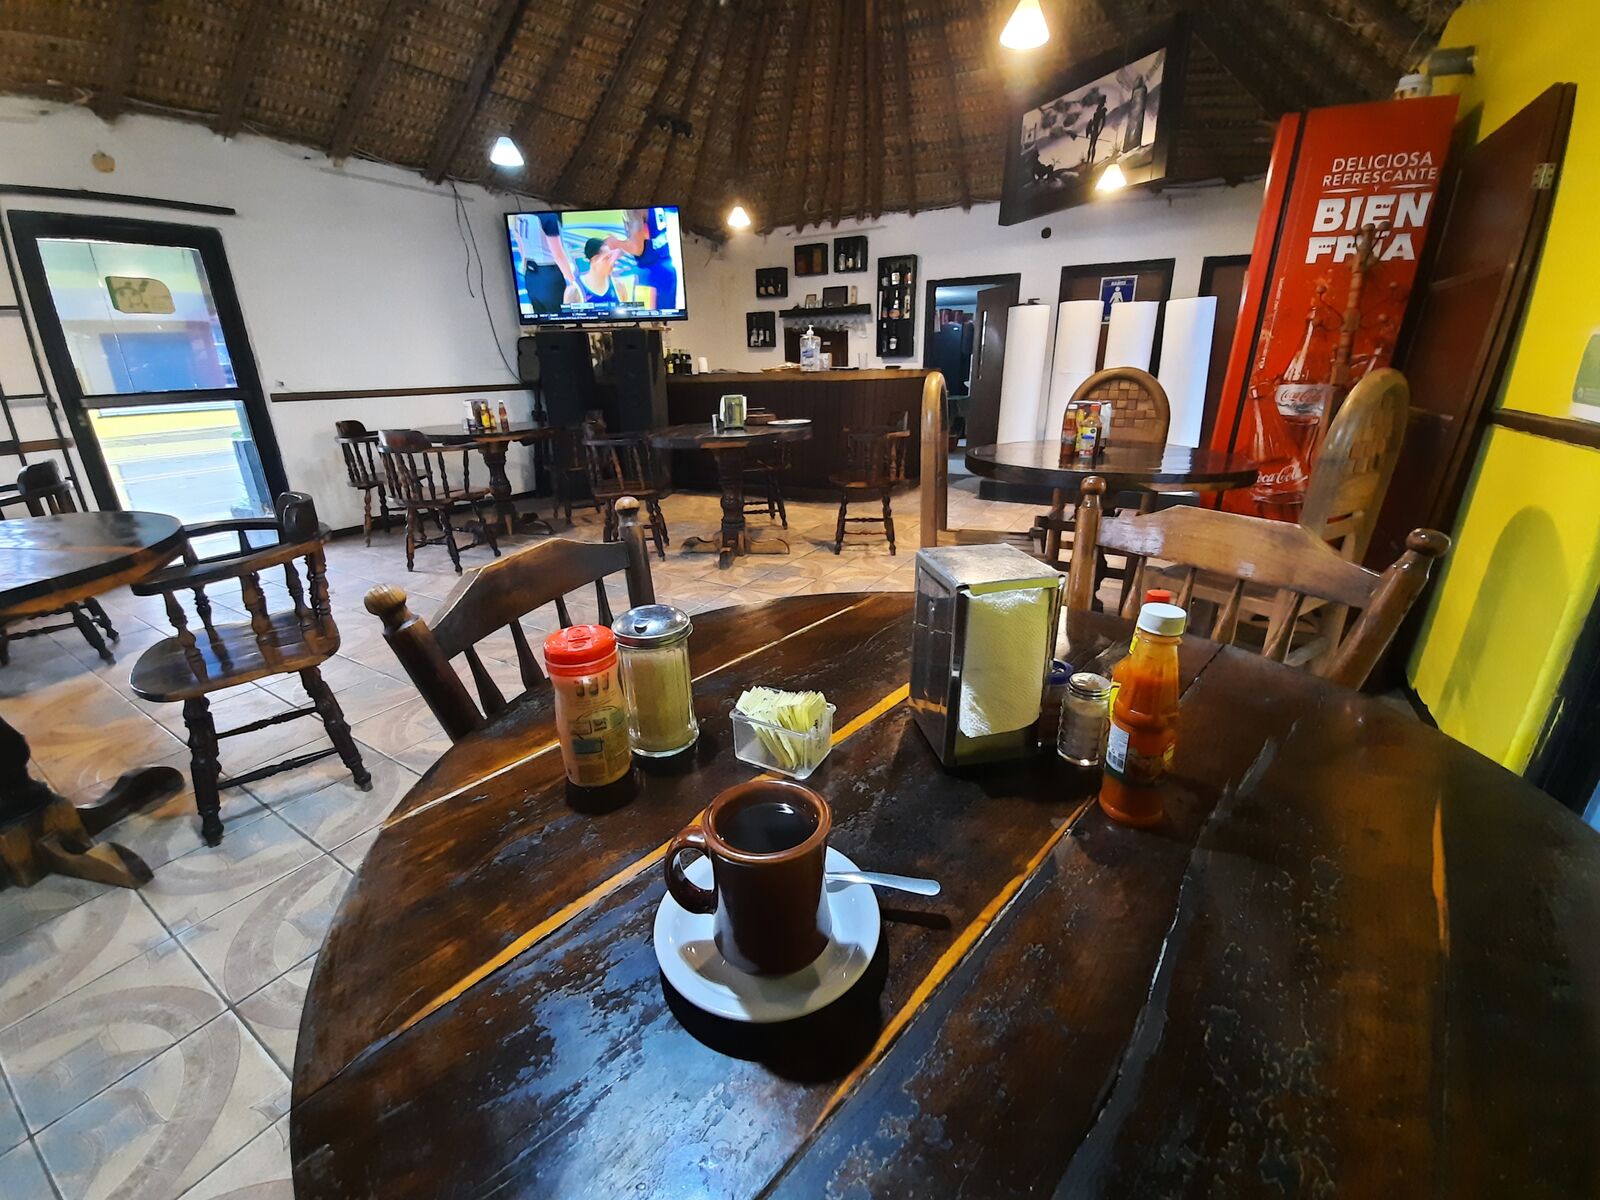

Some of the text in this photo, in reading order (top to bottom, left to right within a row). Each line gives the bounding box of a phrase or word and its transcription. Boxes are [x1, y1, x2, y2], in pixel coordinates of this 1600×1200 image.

[1331, 151, 1433, 173] DELICIOSA
[1322, 167, 1438, 187] REFRESCANTE
[1312, 192, 1433, 233] BIEN
